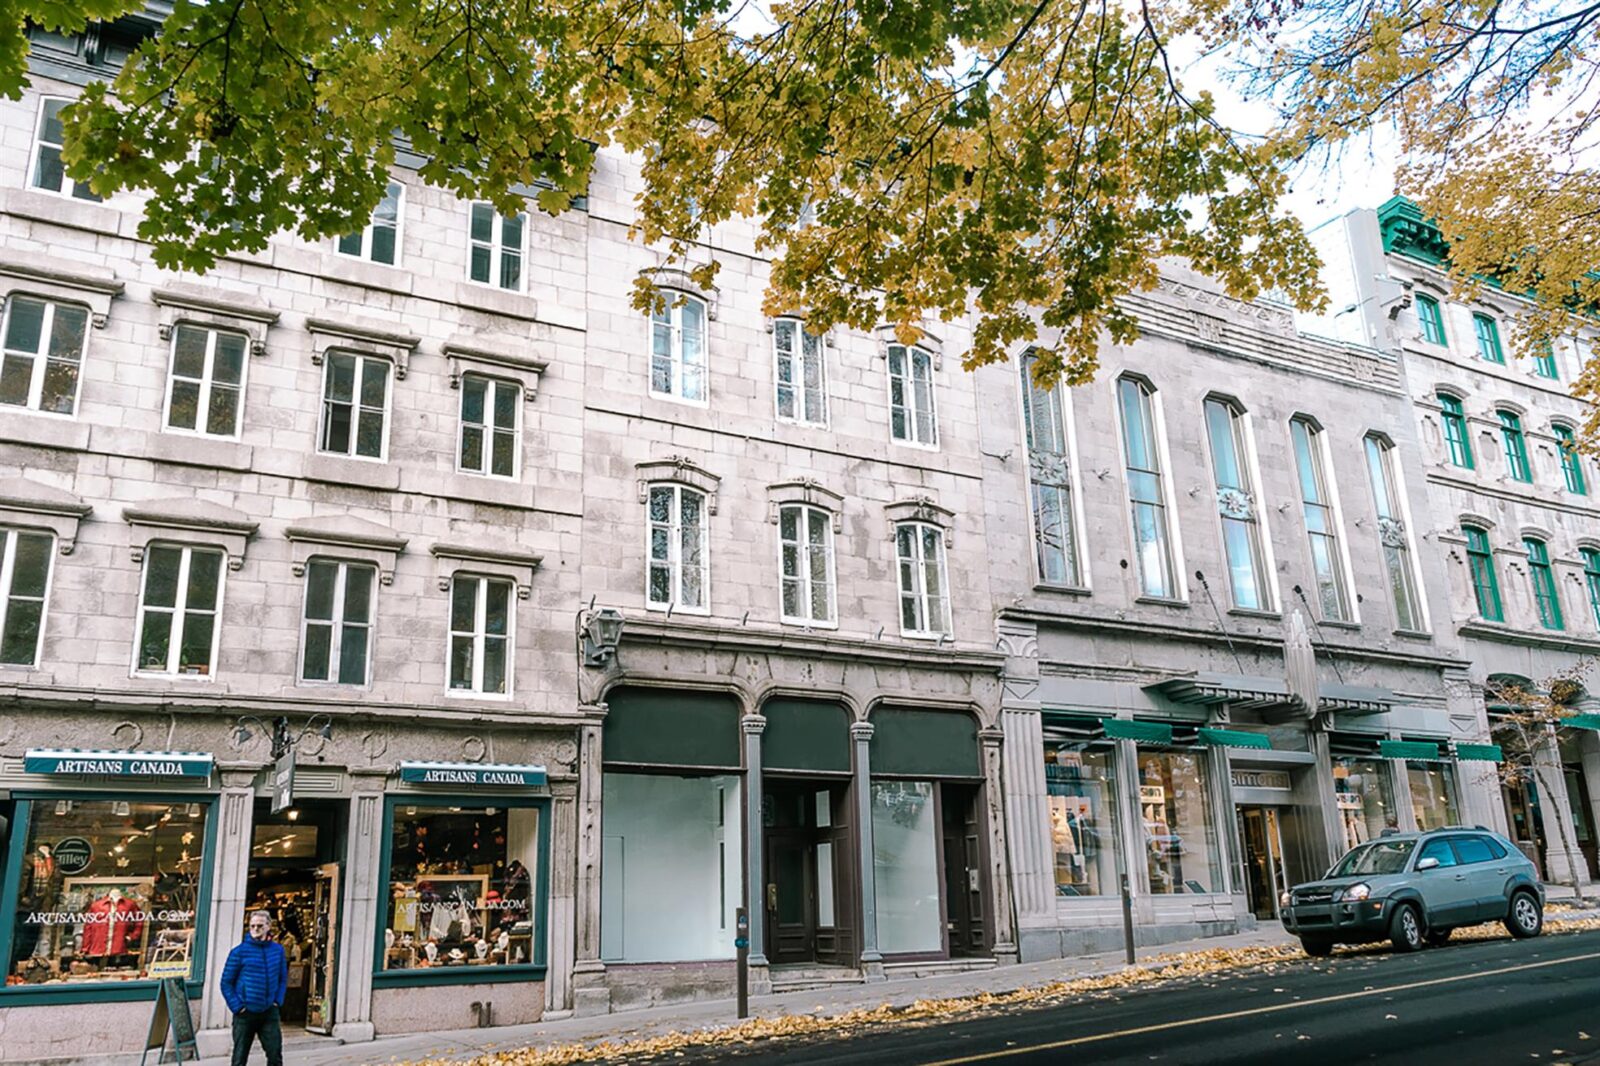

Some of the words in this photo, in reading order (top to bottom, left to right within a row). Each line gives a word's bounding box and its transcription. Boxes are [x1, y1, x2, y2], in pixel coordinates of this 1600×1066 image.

[55, 760, 122, 773] ARTISANS
[130, 761, 183, 775] CANADA
[424, 770, 476, 783] ARTISANS
[483, 772, 525, 784] CANADA
[56, 853, 88, 867] Tilley
[25, 910, 190, 925] ARTISANSCANADA.COM
